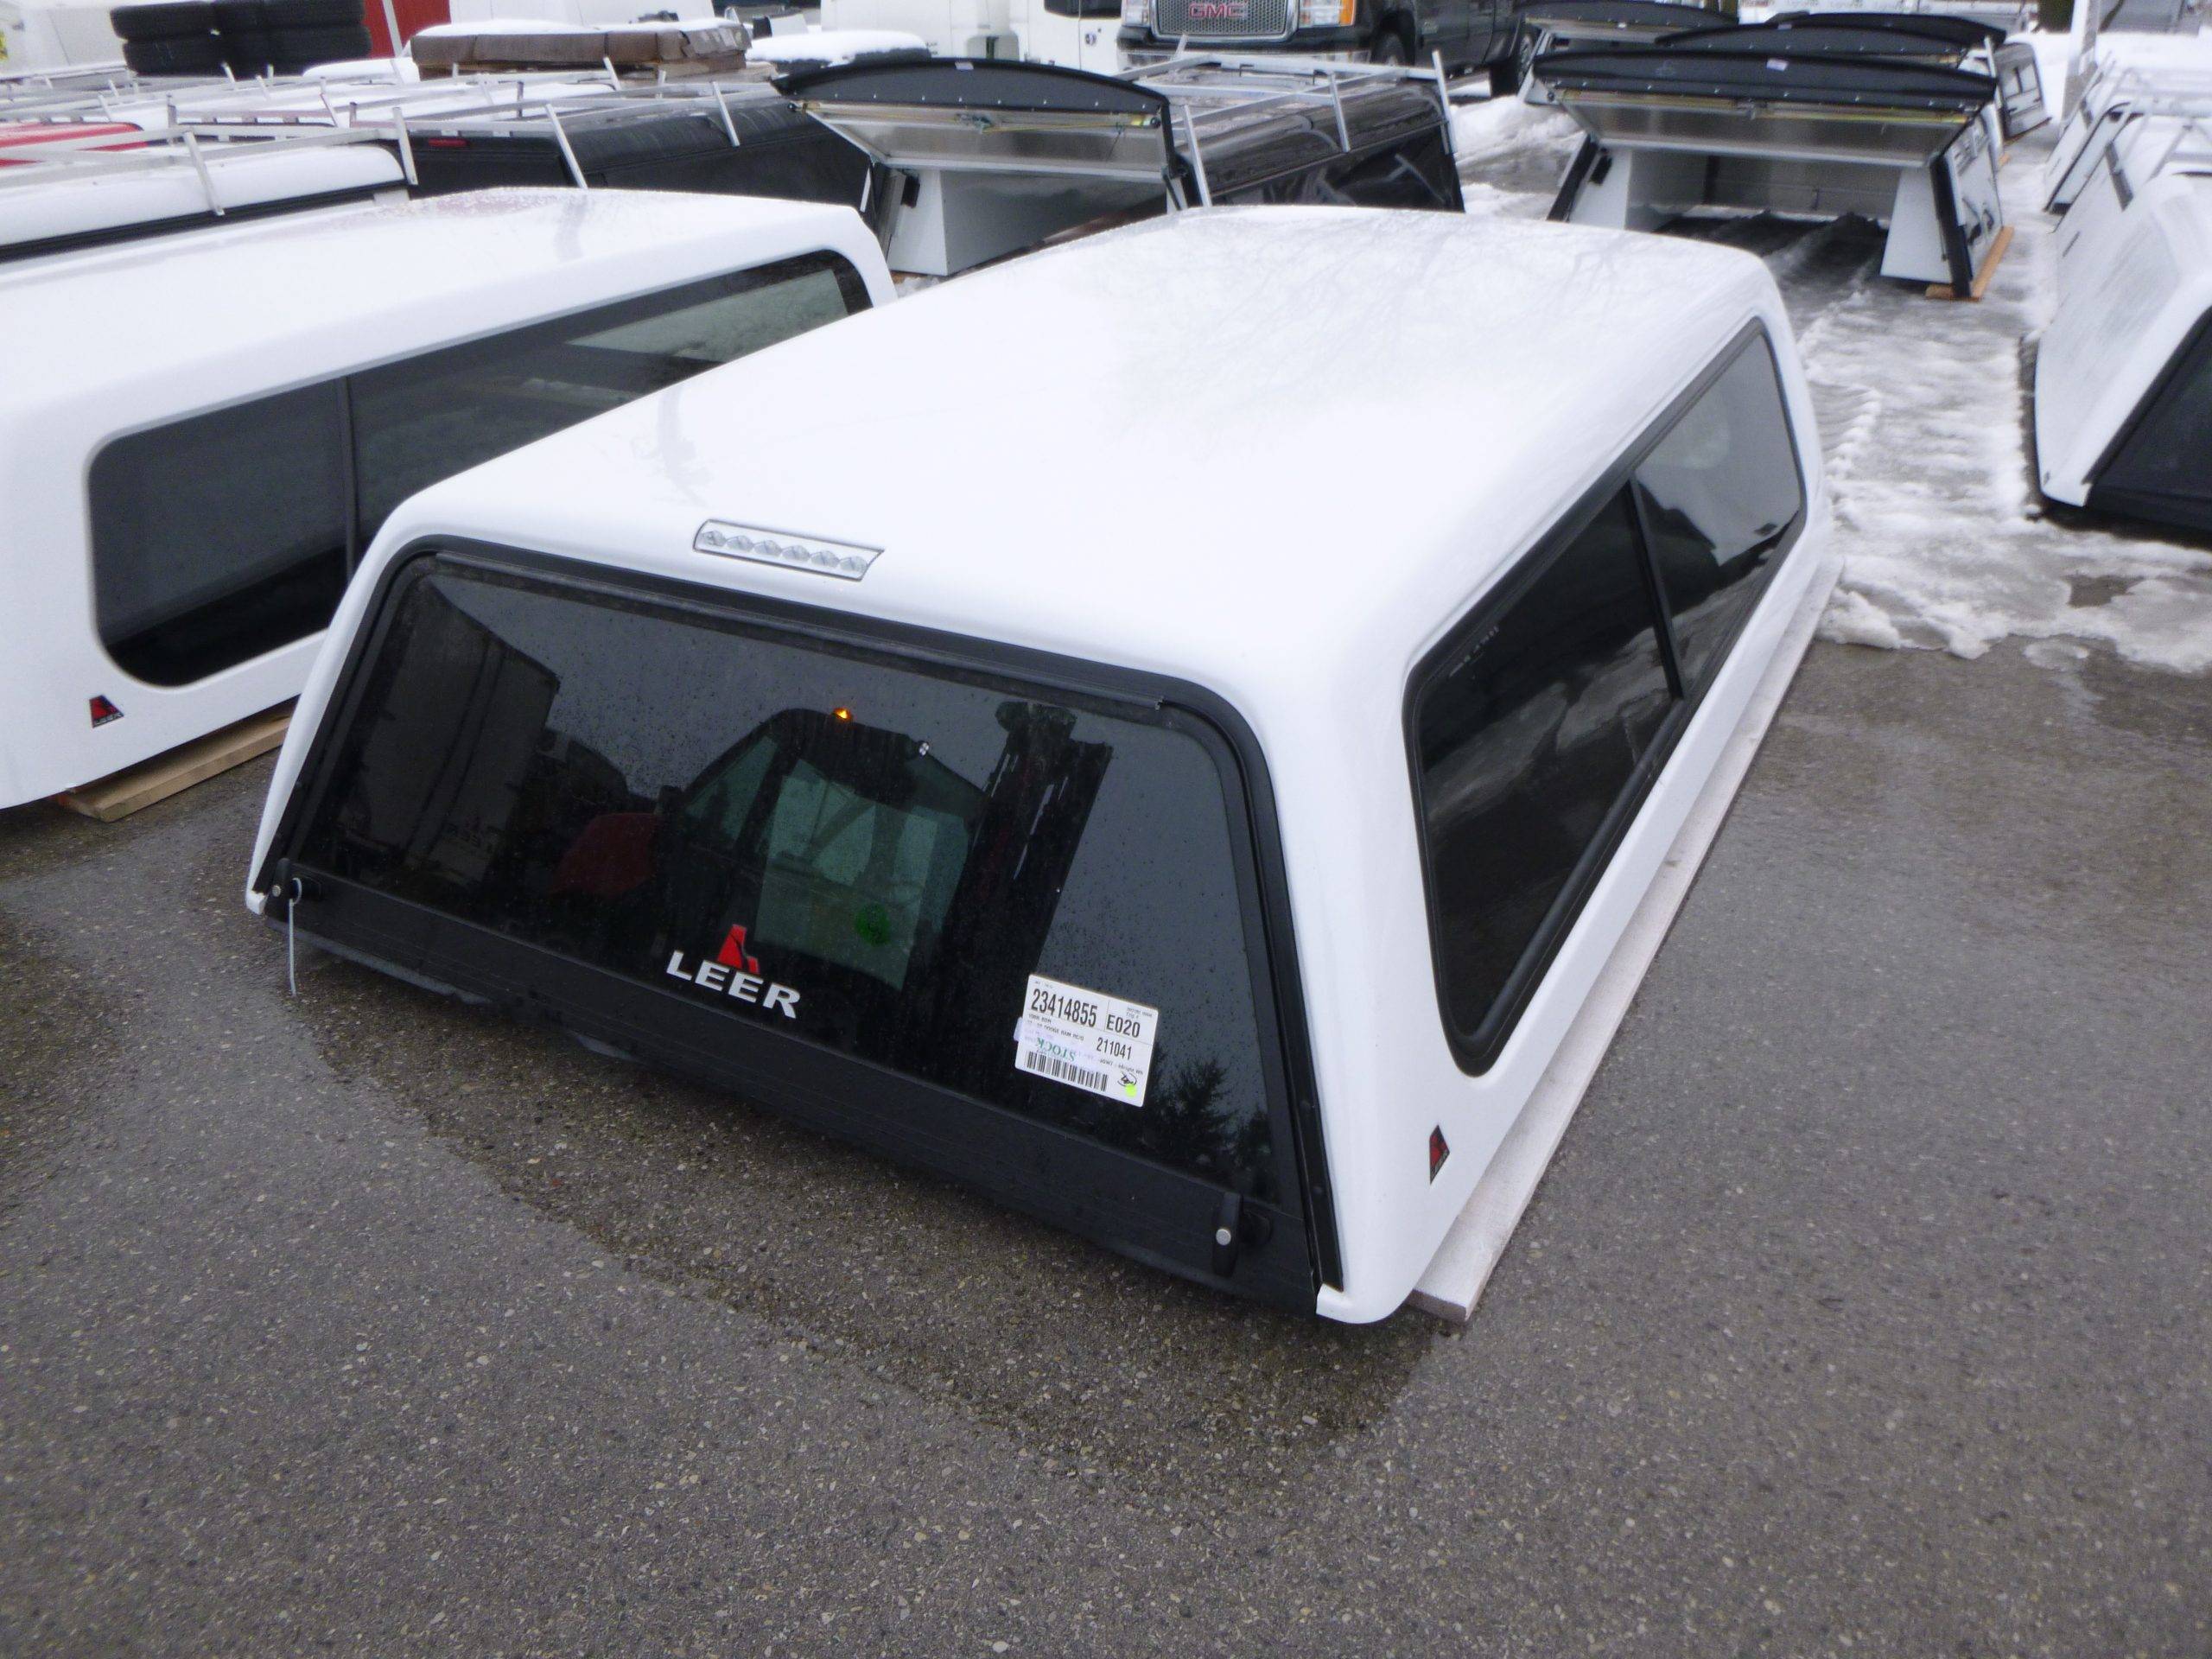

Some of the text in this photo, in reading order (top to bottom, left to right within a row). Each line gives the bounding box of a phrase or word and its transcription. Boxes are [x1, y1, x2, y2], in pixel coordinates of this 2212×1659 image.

[1189, 3, 1244, 18] GMC
[666, 950, 801, 1020] LEER
[1031, 988, 1141, 1039] 23414855 E020
[1096, 1037, 1132, 1061] 211041
